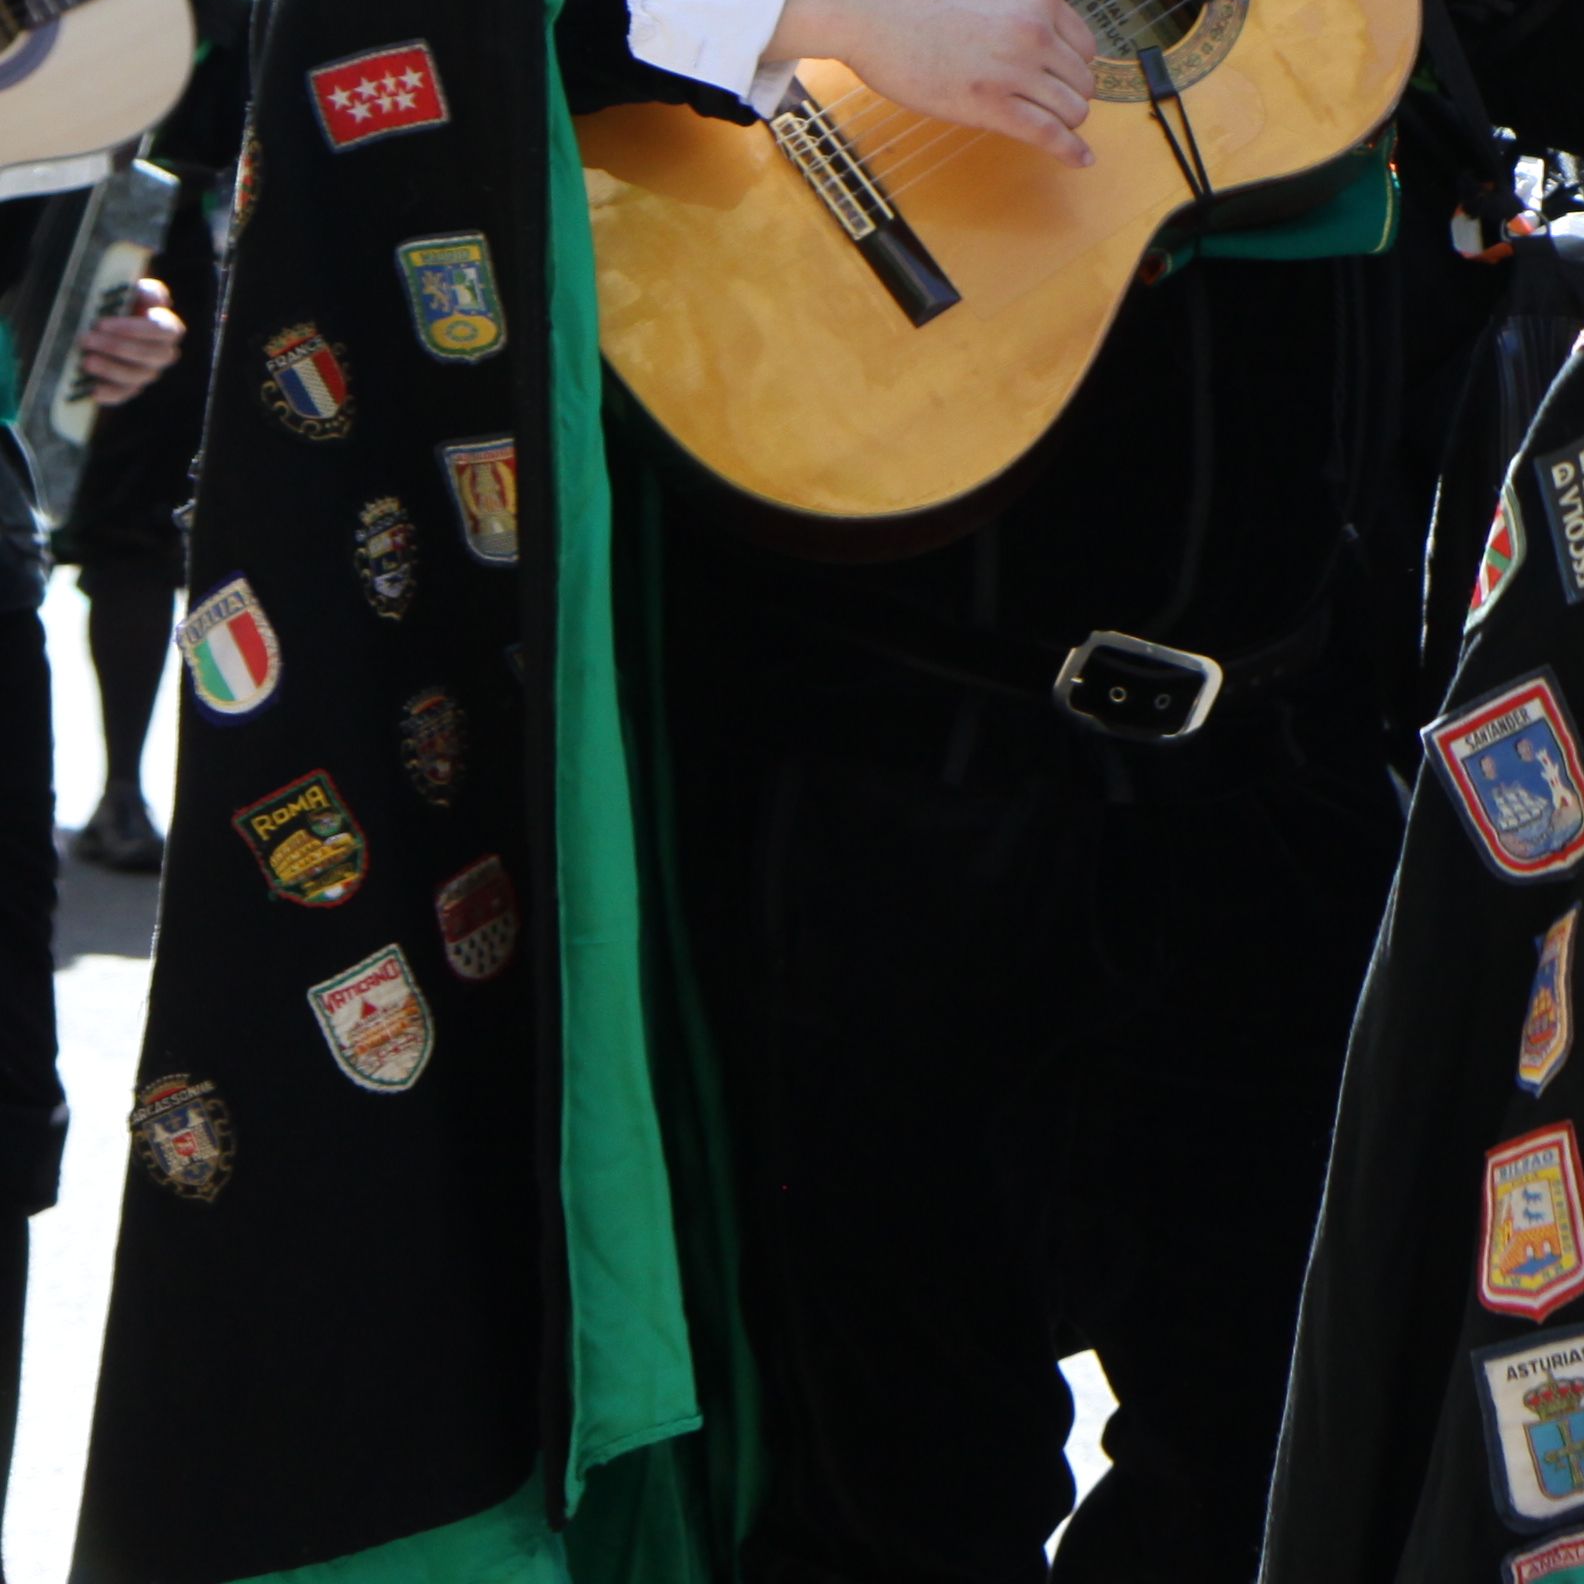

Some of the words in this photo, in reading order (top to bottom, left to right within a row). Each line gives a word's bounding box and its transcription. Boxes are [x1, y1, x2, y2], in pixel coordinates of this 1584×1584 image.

[187, 590, 247, 643] ITALIA
[1464, 707, 1532, 751] SANTANDER
[250, 784, 332, 842] ROMA
